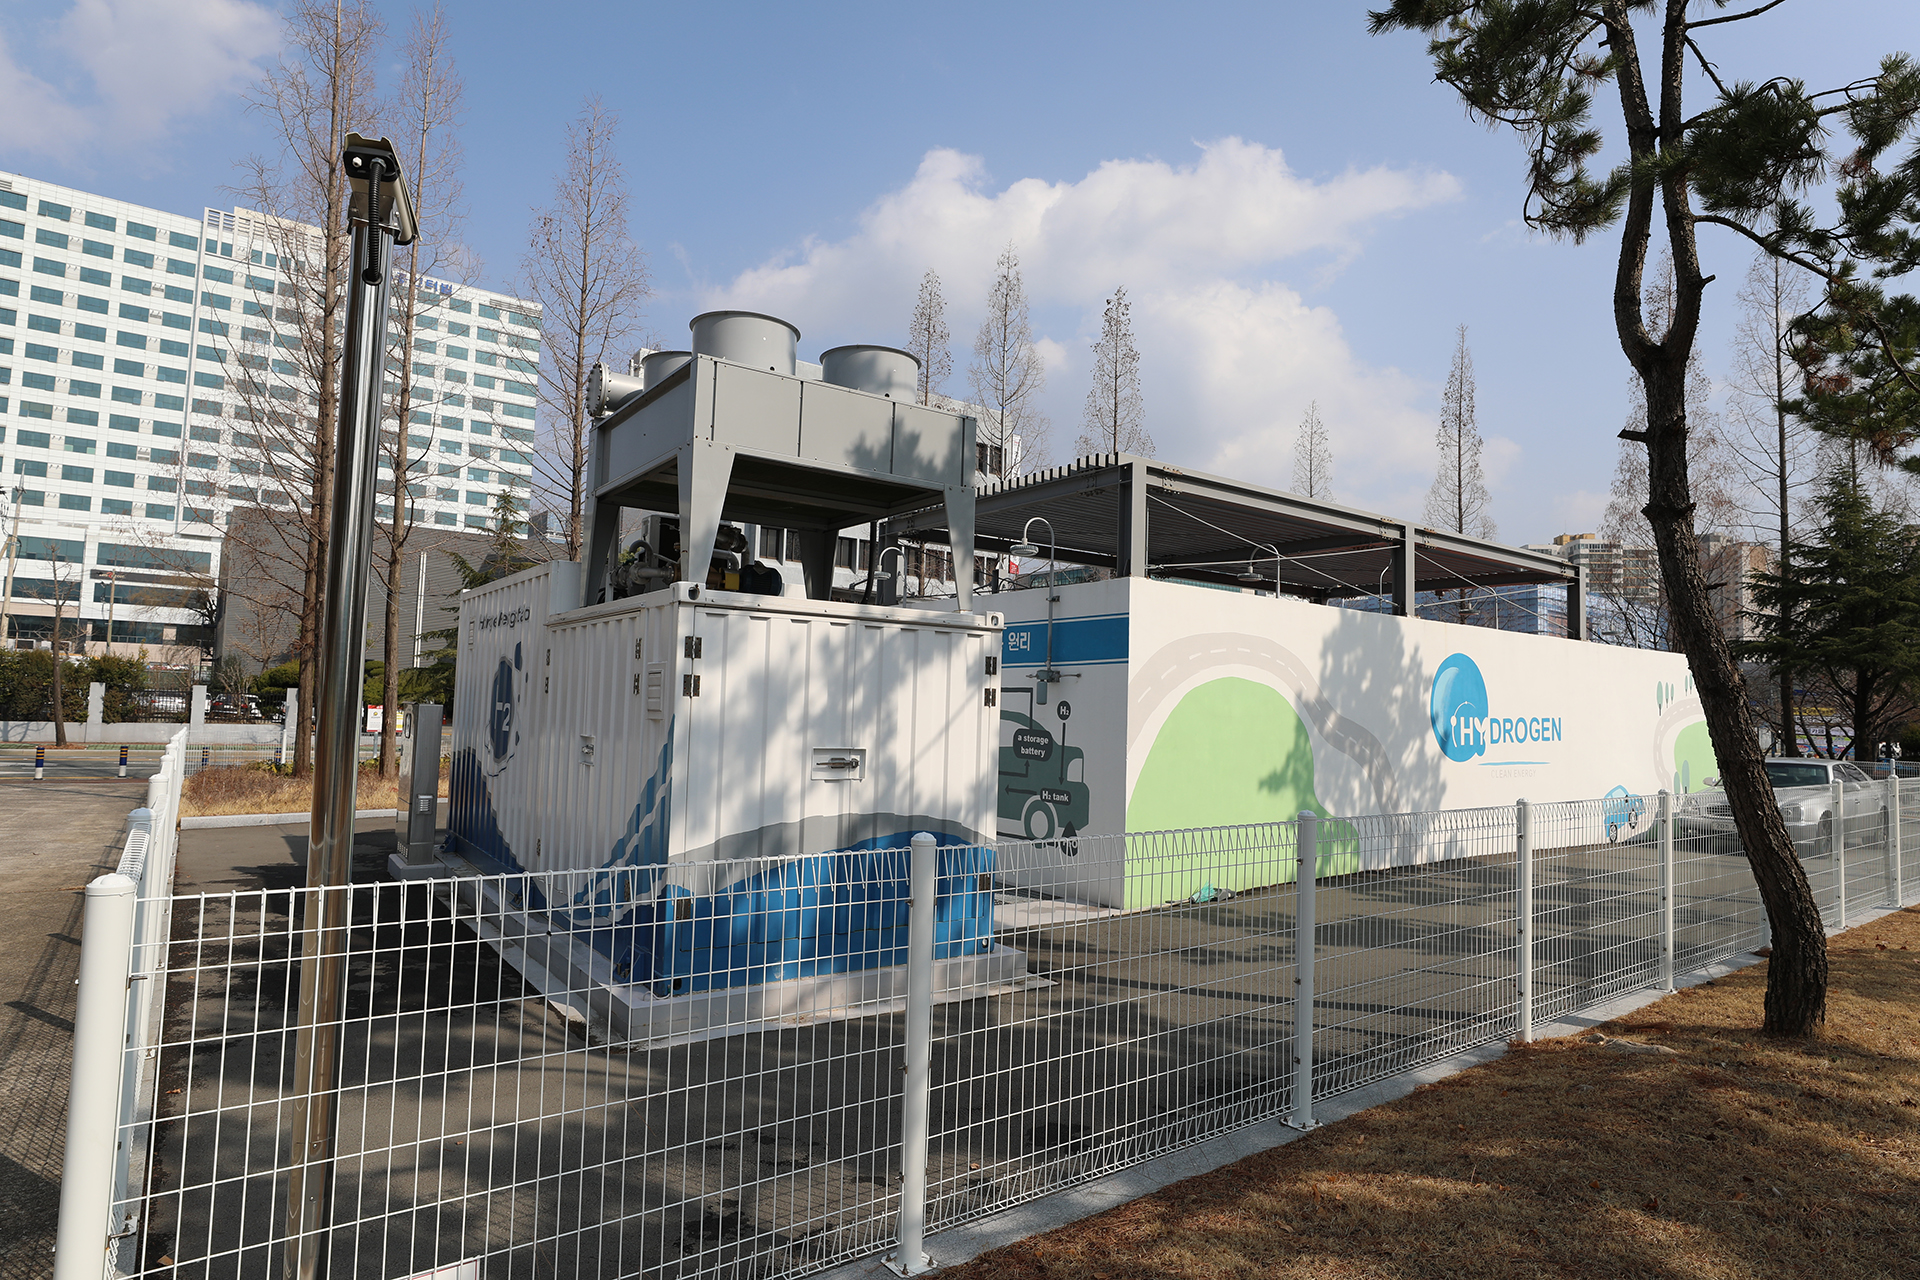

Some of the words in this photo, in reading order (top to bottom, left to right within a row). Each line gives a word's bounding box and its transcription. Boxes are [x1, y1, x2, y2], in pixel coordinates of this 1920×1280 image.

[1008, 631, 1031, 651] 원리
[1460, 716, 1562, 746] HYDROGEN
[1023, 734, 1049, 746] storage
[1020, 746, 1046, 758] battery
[1490, 769, 1512, 779] CLEAN
[1514, 768, 1537, 778] ENERGY
[1052, 791, 1069, 802] tank
